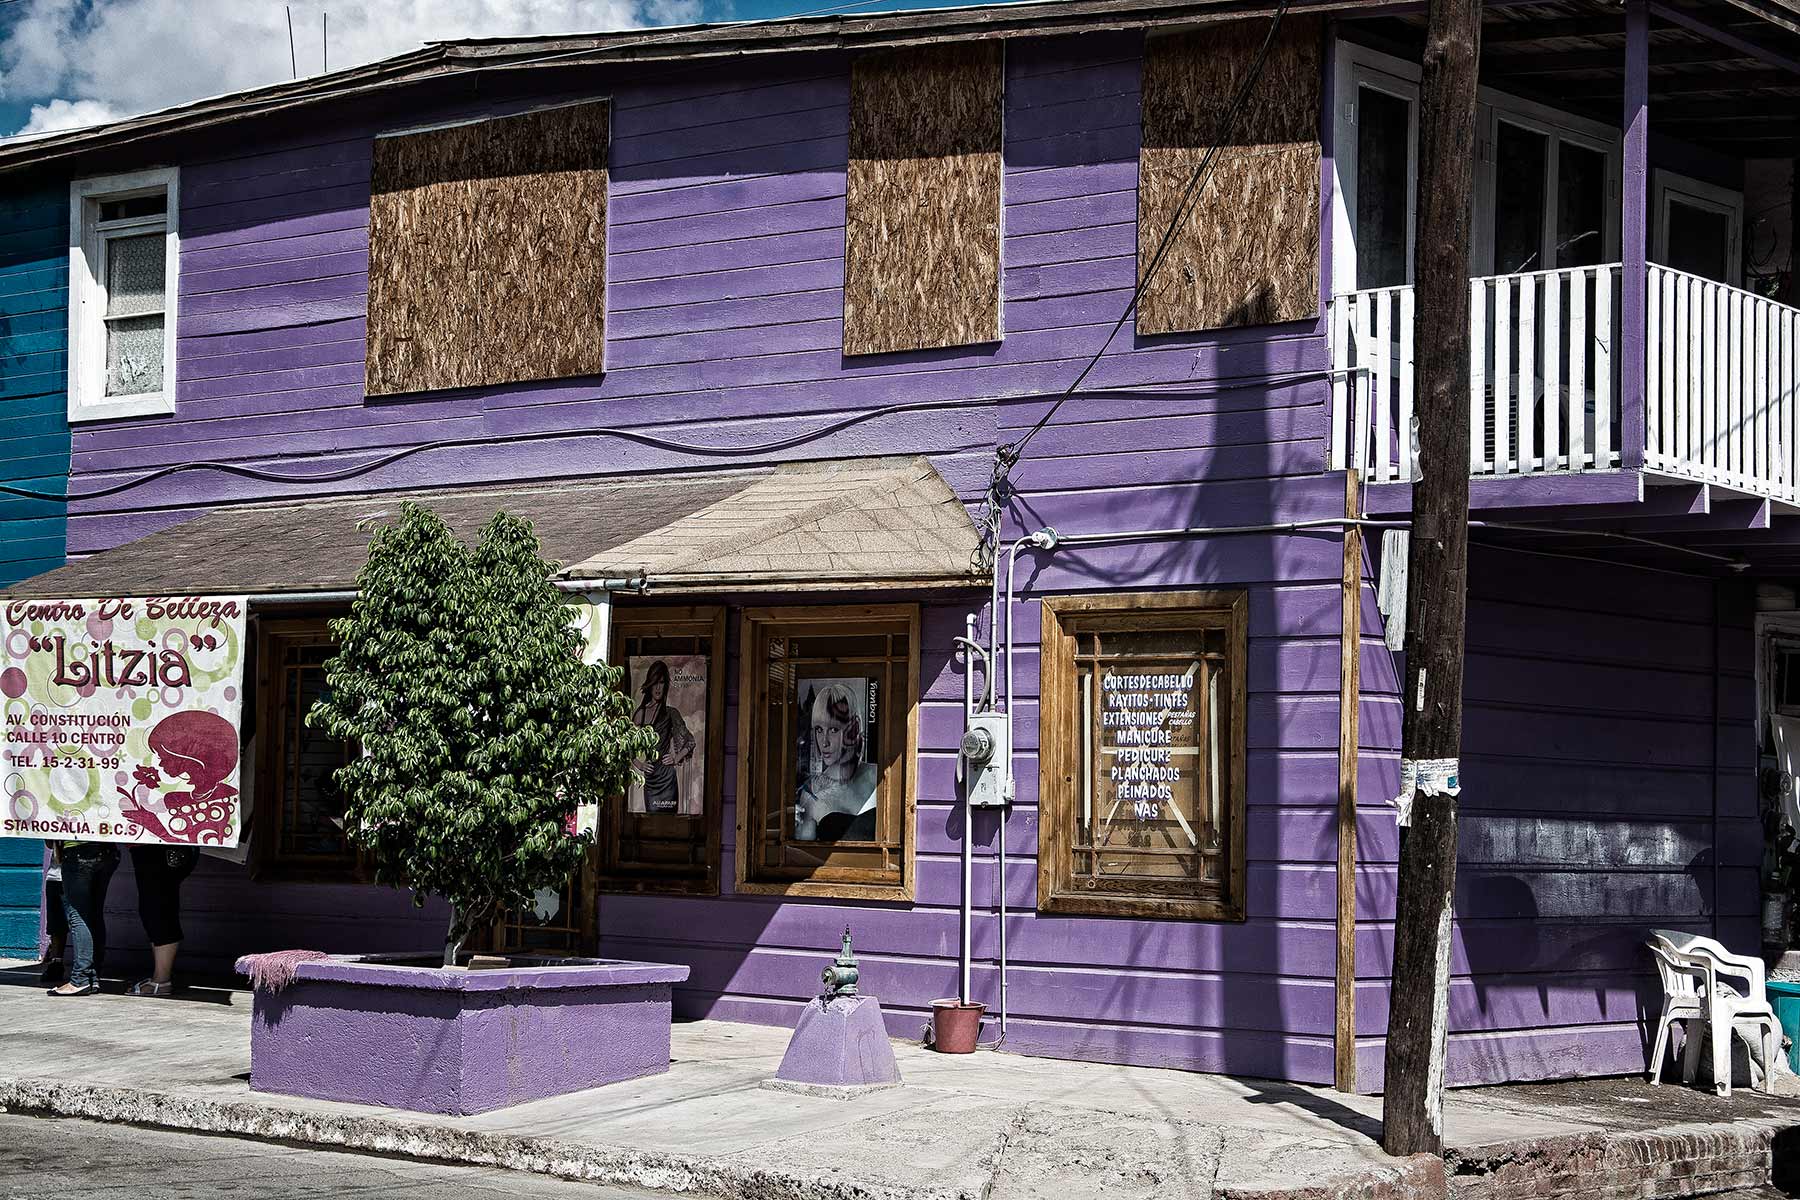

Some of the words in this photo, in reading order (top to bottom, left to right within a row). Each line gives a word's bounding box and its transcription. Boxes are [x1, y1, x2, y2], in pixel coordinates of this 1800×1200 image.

[6, 600, 86, 627] Centro
[98, 598, 134, 621] De
[146, 597, 241, 629] Belleza
[6, 714, 25, 726] AV.
[30, 711, 131, 727] CONSTITUCIÓN
[1103, 711, 1164, 727] EXTENSIONES
[7, 731, 48, 744] CALLE
[51, 732, 68, 744] 10
[71, 732, 126, 745] CENTRO
[1117, 729, 1172, 745] MANICURE
[10, 755, 37, 768] TEL.
[42, 756, 120, 770] 15-2-31-99
[1117, 748, 1172, 763] PEDICURE
[1111, 766, 1181, 782] PLANCHADOS
[1117, 784, 1172, 800] PEINADOS
[4, 819, 29, 833] STA
